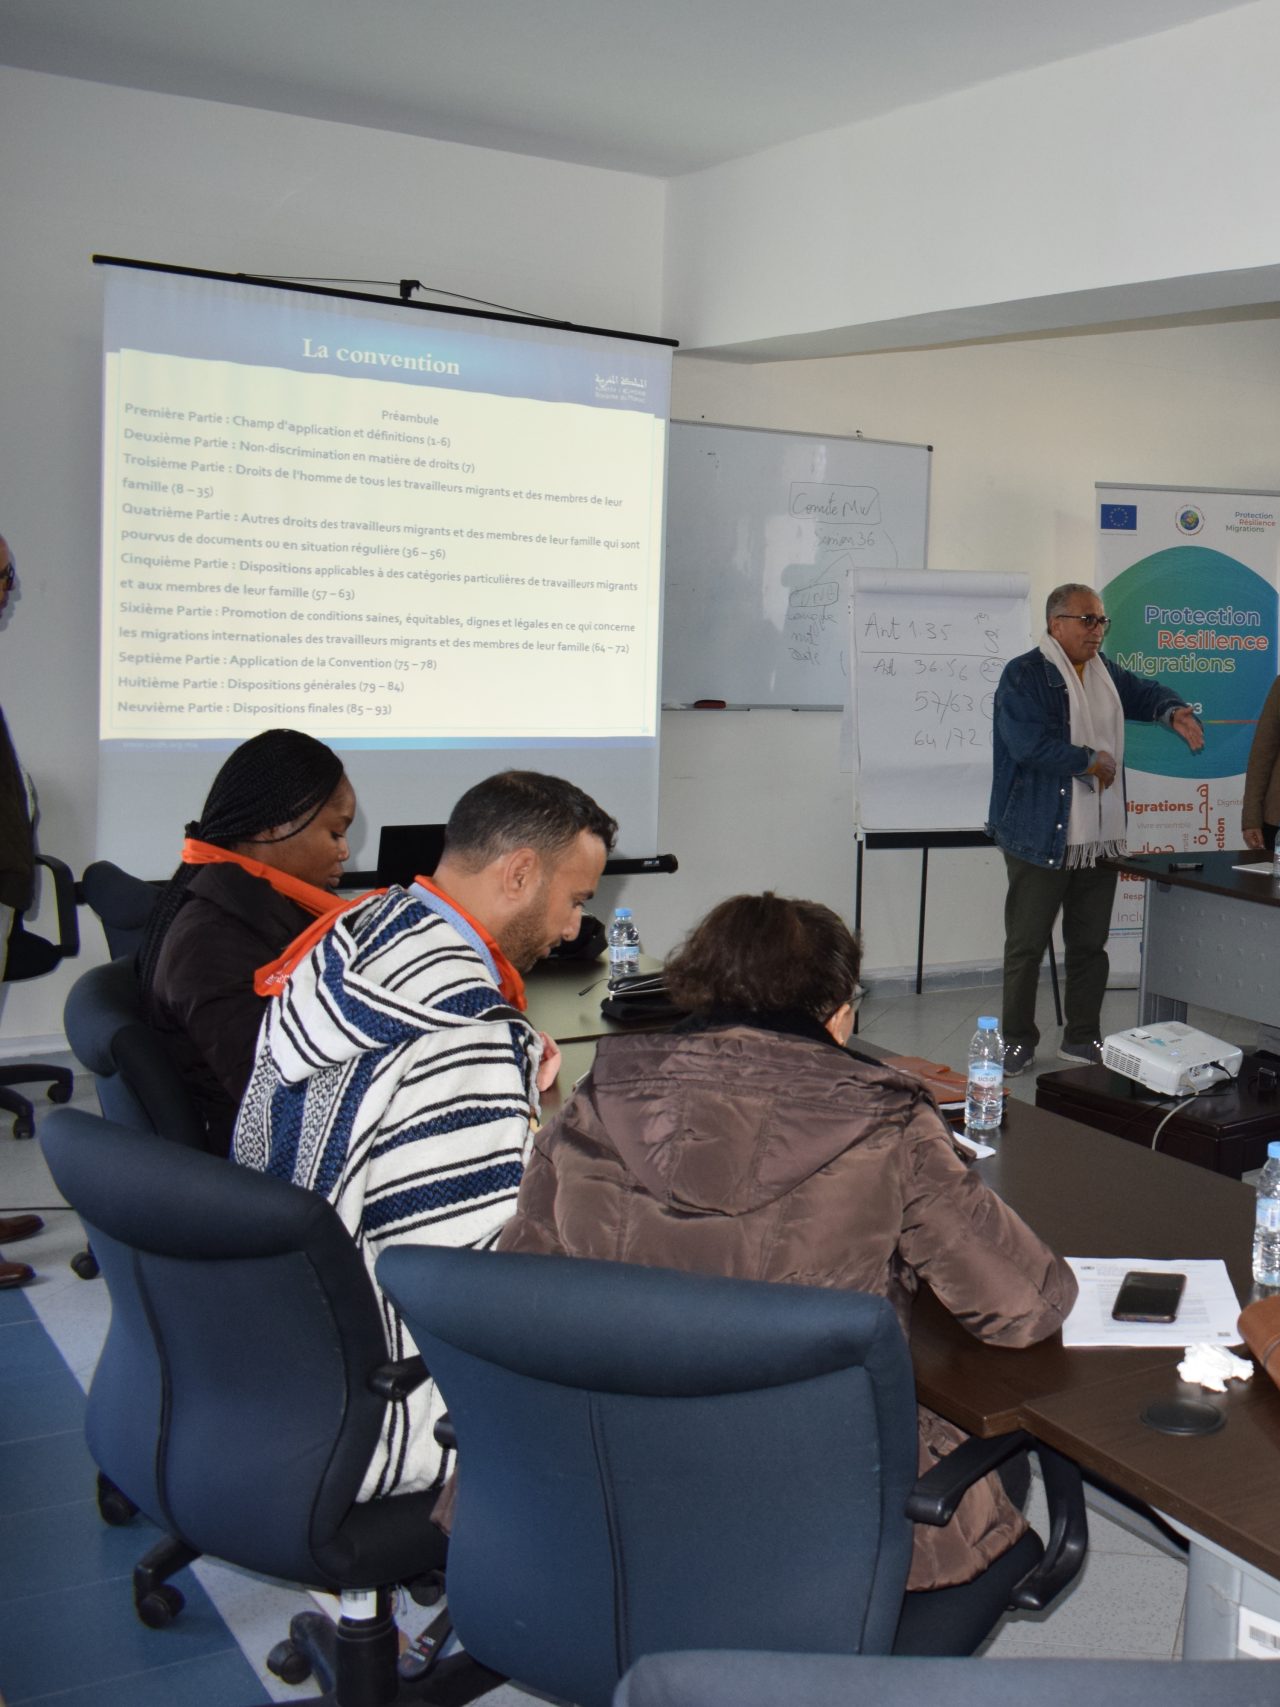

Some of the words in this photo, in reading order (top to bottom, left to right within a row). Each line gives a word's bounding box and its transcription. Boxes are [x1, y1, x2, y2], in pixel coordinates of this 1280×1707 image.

[302, 338, 328, 358] La
[336, 347, 460, 375] convention
[124, 402, 185, 420] Première
[187, 410, 223, 423] Partie
[231, 414, 275, 431] Champ
[352, 428, 364, 438] et
[365, 428, 425, 444] définitions
[380, 409, 439, 425] Préambule
[123, 427, 191, 445] Deuxième
[193, 435, 229, 448] Partie
[238, 440, 350, 460] Non-discrimination
[351, 452, 366, 461] en
[367, 453, 411, 466] matière
[412, 456, 427, 468] de
[428, 458, 460, 470] droits
[121, 476, 169, 492] famille
[122, 452, 188, 470] Troisième
[190, 460, 225, 472] Partie
[234, 463, 272, 477] Droits
[273, 466, 290, 479] de
[344, 472, 358, 484] de
[358, 474, 385, 487] tous
[386, 476, 402, 488] les
[402, 479, 463, 493] travailleurs
[464, 485, 511, 498] migrants
[512, 489, 524, 499] et
[524, 489, 542, 500] des
[543, 493, 588, 503] membres
[589, 494, 603, 505] de
[604, 495, 623, 507] leur
[121, 502, 193, 519] Quatrième
[195, 508, 231, 520] Partie
[240, 512, 280, 525] Autres
[281, 515, 318, 528] droits
[319, 518, 338, 529] des
[339, 520, 401, 532] travailleurs
[402, 524, 451, 537] migrants
[452, 528, 464, 538] et
[465, 528, 484, 539] des
[485, 531, 534, 542] membres
[534, 532, 548, 544] de
[548, 534, 569, 545] leur
[569, 535, 602, 546] famille
[602, 538, 619, 550] qui
[620, 540, 640, 549] sont
[1235, 511, 1273, 519] Protection
[1225, 525, 1265, 533] Migrations
[120, 529, 175, 542] pourvus
[176, 531, 193, 544] de
[194, 533, 263, 548] documents
[264, 539, 280, 549] ou
[281, 540, 298, 550] en
[300, 541, 349, 552] situation
[350, 542, 400, 556] régulière
[120, 552, 191, 568] Cinquième
[193, 557, 229, 569] Partie
[238, 560, 312, 574] Dispositions
[314, 564, 375, 577] applicables
[376, 566, 384, 578] à
[385, 567, 404, 579] des
[405, 569, 462, 582] catégories
[462, 573, 526, 585] particulières
[526, 575, 540, 586] de
[541, 578, 595, 589] travailleurs
[595, 579, 638, 592] migrants
[119, 578, 134, 589] et
[136, 580, 162, 591] aux
[165, 582, 222, 593] membres
[222, 582, 240, 594] de
[242, 583, 266, 596] leur
[267, 584, 309, 598] famille
[119, 601, 174, 615] Sixième
[176, 604, 212, 616] Partie
[220, 605, 287, 619] Promotion
[288, 609, 304, 621] de
[306, 610, 364, 621] conditions
[465, 616, 500, 629] dignes
[501, 618, 512, 628] et
[513, 617, 549, 630] légales
[550, 621, 563, 630] en
[564, 622, 576, 631] ce
[577, 620, 592, 633] qui
[592, 622, 636, 632] concerne
[1145, 605, 1260, 627] Protection
[118, 626, 137, 638] les
[140, 628, 209, 642] migrations
[210, 630, 303, 644] internationales
[304, 633, 324, 644] des
[325, 634, 388, 645] travailleurs
[389, 635, 438, 648] migrants
[438, 637, 450, 647] et
[451, 637, 471, 648] des
[472, 639, 520, 649] membres
[520, 639, 534, 650] de
[535, 640, 556, 651] leur
[556, 641, 590, 652] famille
[1157, 629, 1269, 651] Résilience
[118, 651, 182, 665] Septième
[184, 653, 220, 665] Partie
[228, 654, 298, 668] Application
[300, 656, 315, 667] de
[316, 655, 326, 667] la
[327, 656, 392, 668] Convention
[1117, 652, 1235, 676] Migrations
[117, 676, 180, 688] Huitième
[182, 677, 218, 689] Partie
[226, 678, 301, 691] Dispositions
[302, 679, 357, 693] générales
[116, 700, 185, 713] Neuvième
[187, 701, 223, 713] Partie
[232, 702, 306, 715] Dispositions
[307, 702, 344, 713] finales
